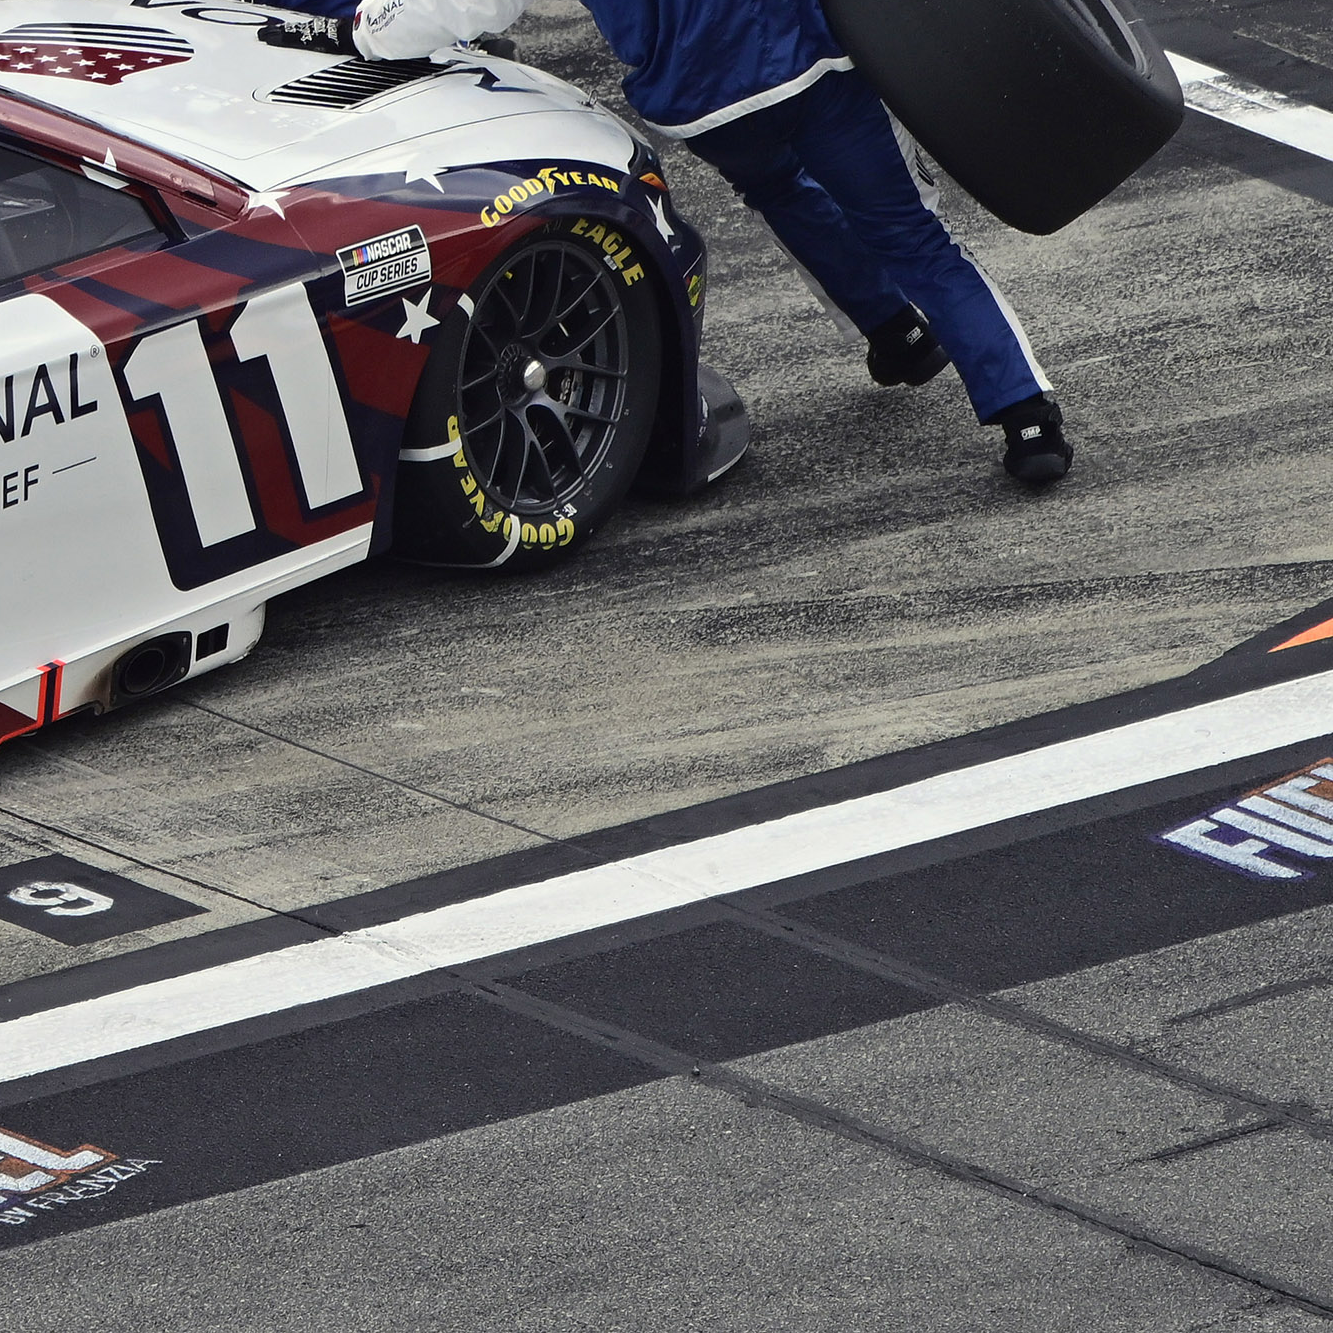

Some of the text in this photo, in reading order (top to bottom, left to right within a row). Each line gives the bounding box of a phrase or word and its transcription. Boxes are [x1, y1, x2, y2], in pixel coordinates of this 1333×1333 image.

[480, 167, 621, 228] GOODYEAR
[356, 258, 420, 291] CUP SERIES
[367, 234, 412, 265] NASCAR
[570, 218, 645, 287] EAGLE
[121, 282, 364, 551] 11
[1162, 764, 1333, 879] FU
[7, 880, 115, 918] 9
[29, 1157, 161, 1214] FRANZIA
